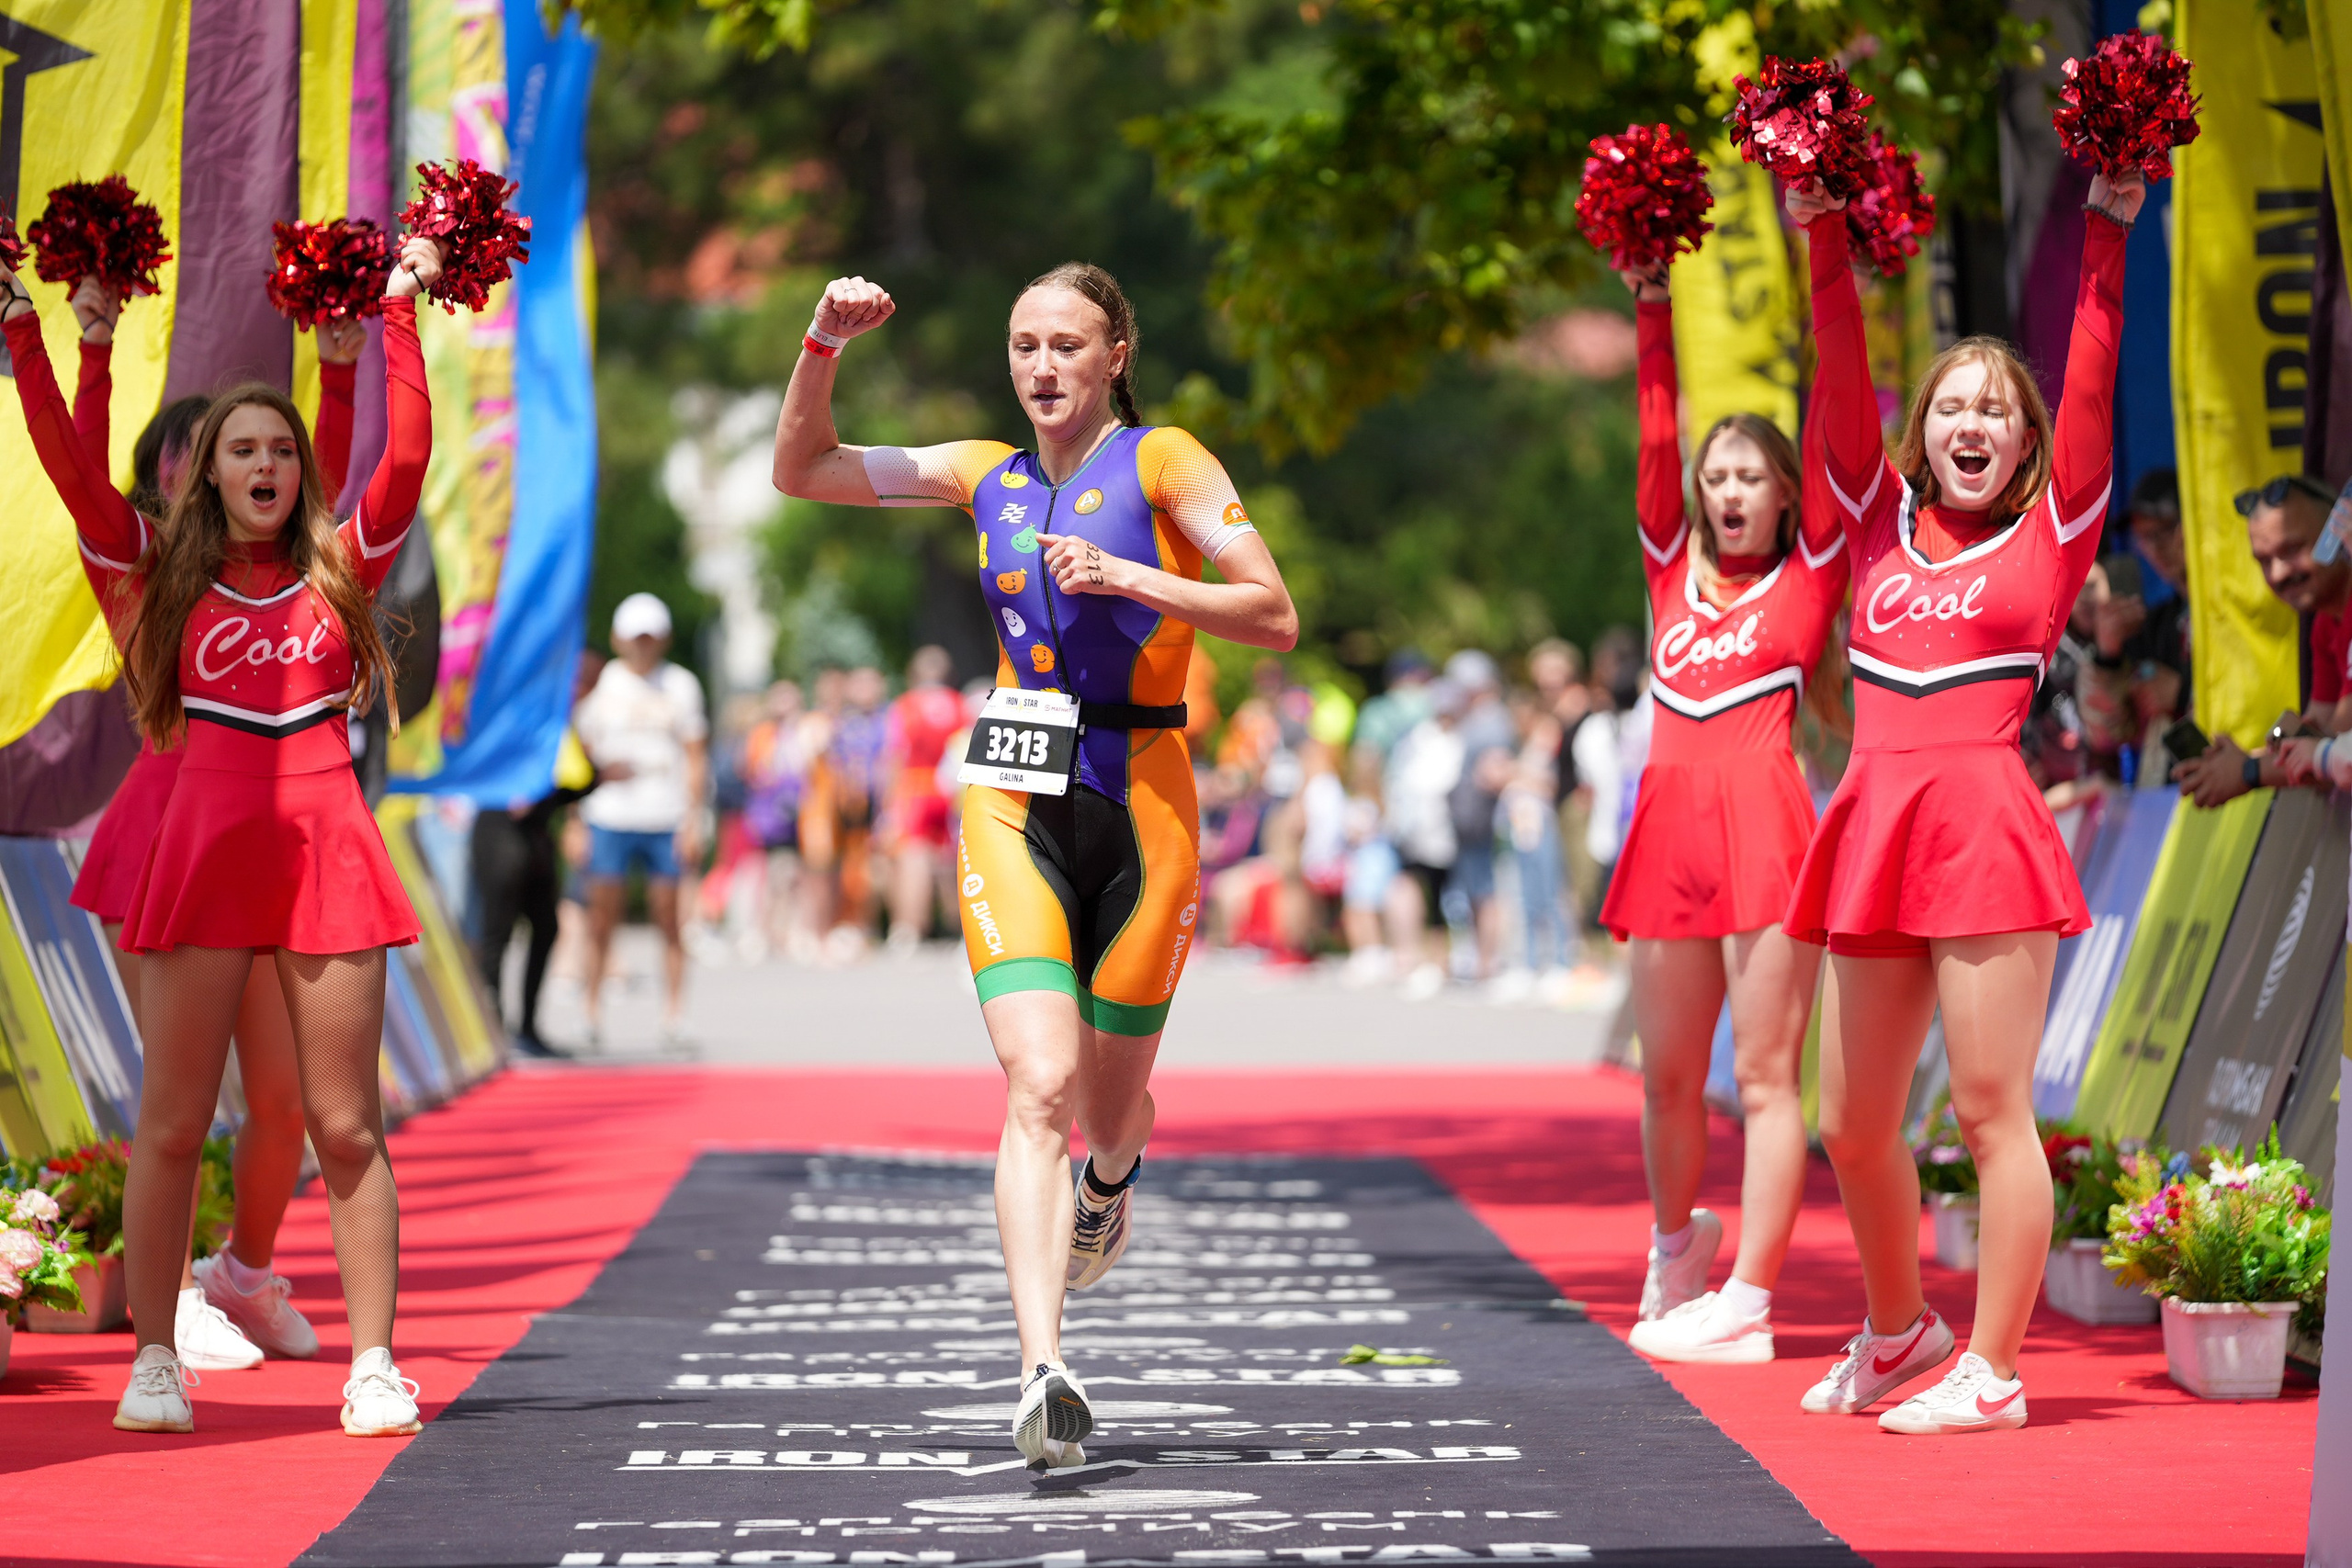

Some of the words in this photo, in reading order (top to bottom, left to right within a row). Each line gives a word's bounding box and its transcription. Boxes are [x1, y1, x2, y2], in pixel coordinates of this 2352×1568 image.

[1086, 542, 1104, 586] 3213
[1866, 572, 1987, 634] Cool
[196, 616, 329, 682] Cool
[1656, 613, 1758, 679] Cool
[1006, 696, 1018, 706] IRON
[1023, 698, 1038, 708] STAR
[986, 726, 1049, 766] 3213
[999, 772, 1023, 783] GALINA
[970, 900, 1005, 956] ДИКСИ
[1162, 934, 1187, 995] ДИКСИ
[675, 1371, 977, 1385] IRON
[1141, 1369, 1462, 1382] STAR
[637, 1419, 1496, 1429] Газпрмбанк
[776, 1428, 1361, 1438] Преиум
[628, 1450, 970, 1465] IRON
[1158, 1446, 1522, 1461] STAR
[560, 1549, 956, 1566] IRON
[1173, 1541, 1592, 1563] STAR
